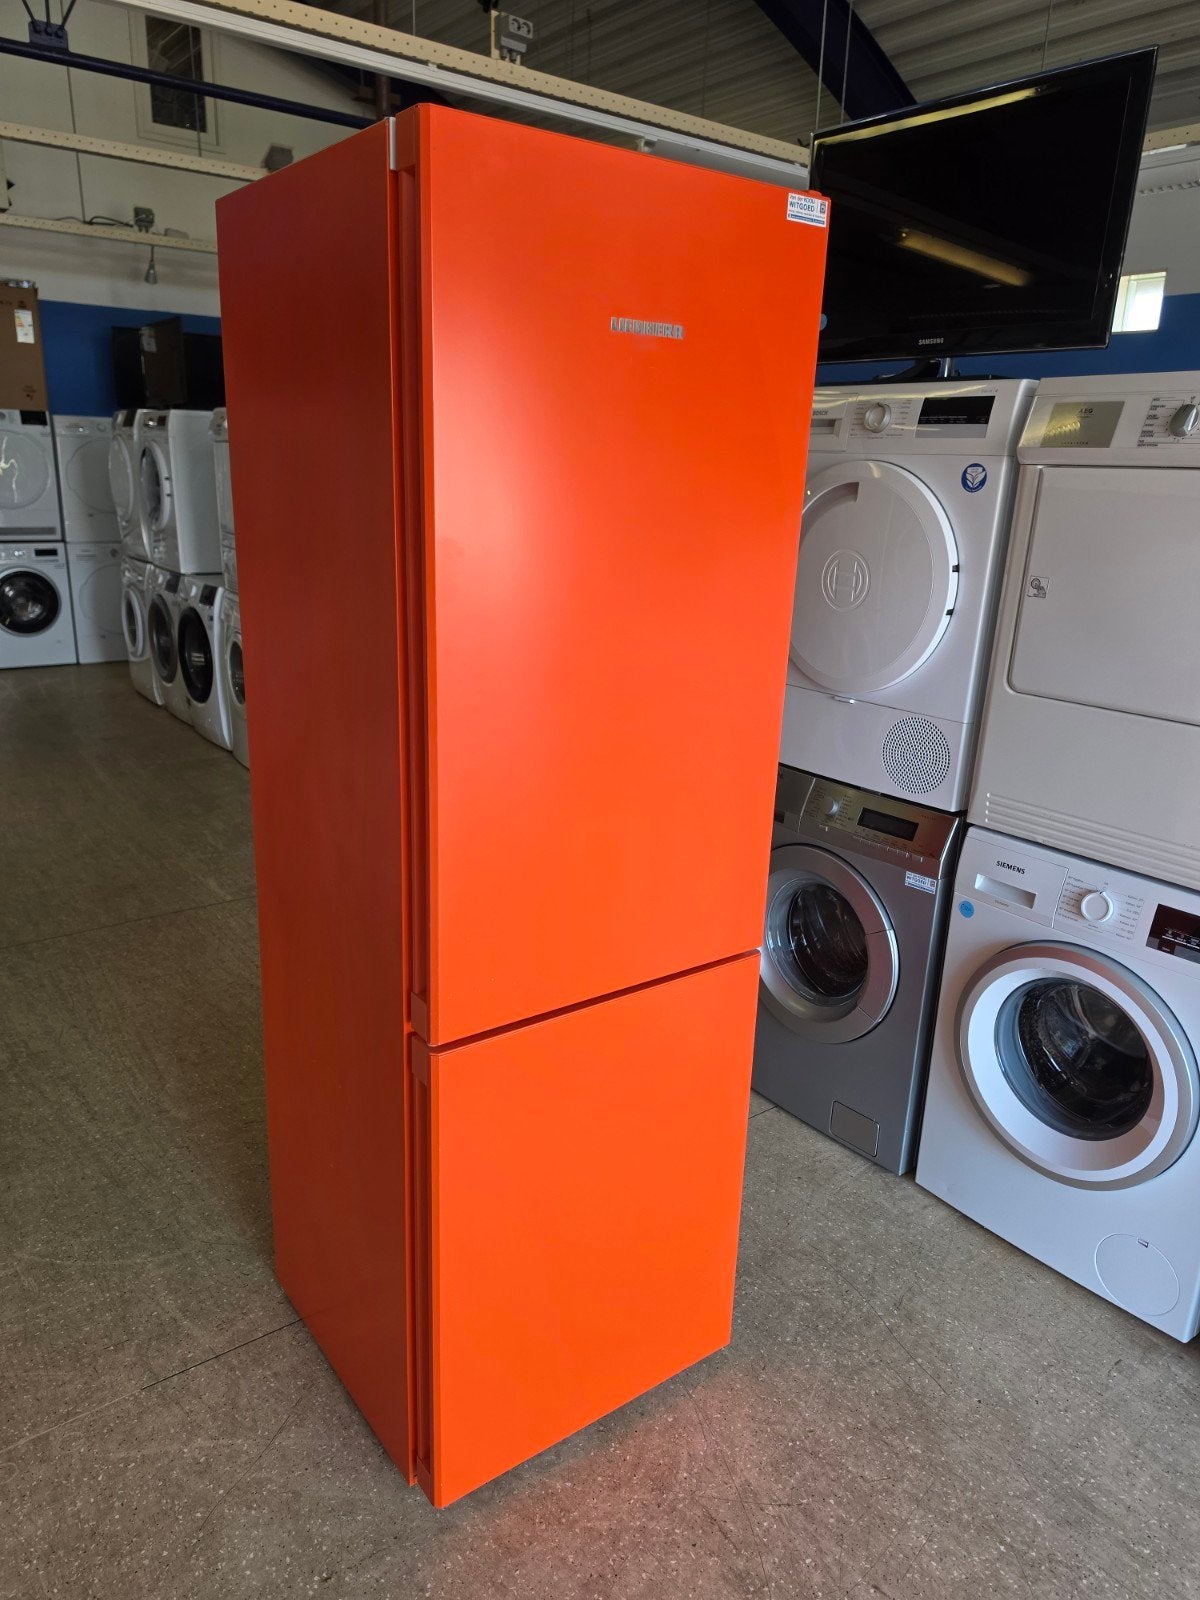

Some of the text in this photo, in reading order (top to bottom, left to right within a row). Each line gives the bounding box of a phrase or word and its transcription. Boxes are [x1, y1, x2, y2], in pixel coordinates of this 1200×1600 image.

[789, 201, 815, 212] WITGOED
[611, 316, 683, 339] LIEBHERR
[918, 337, 944, 345] SAMSUNG
[996, 860, 1026, 875] SIEMENS
